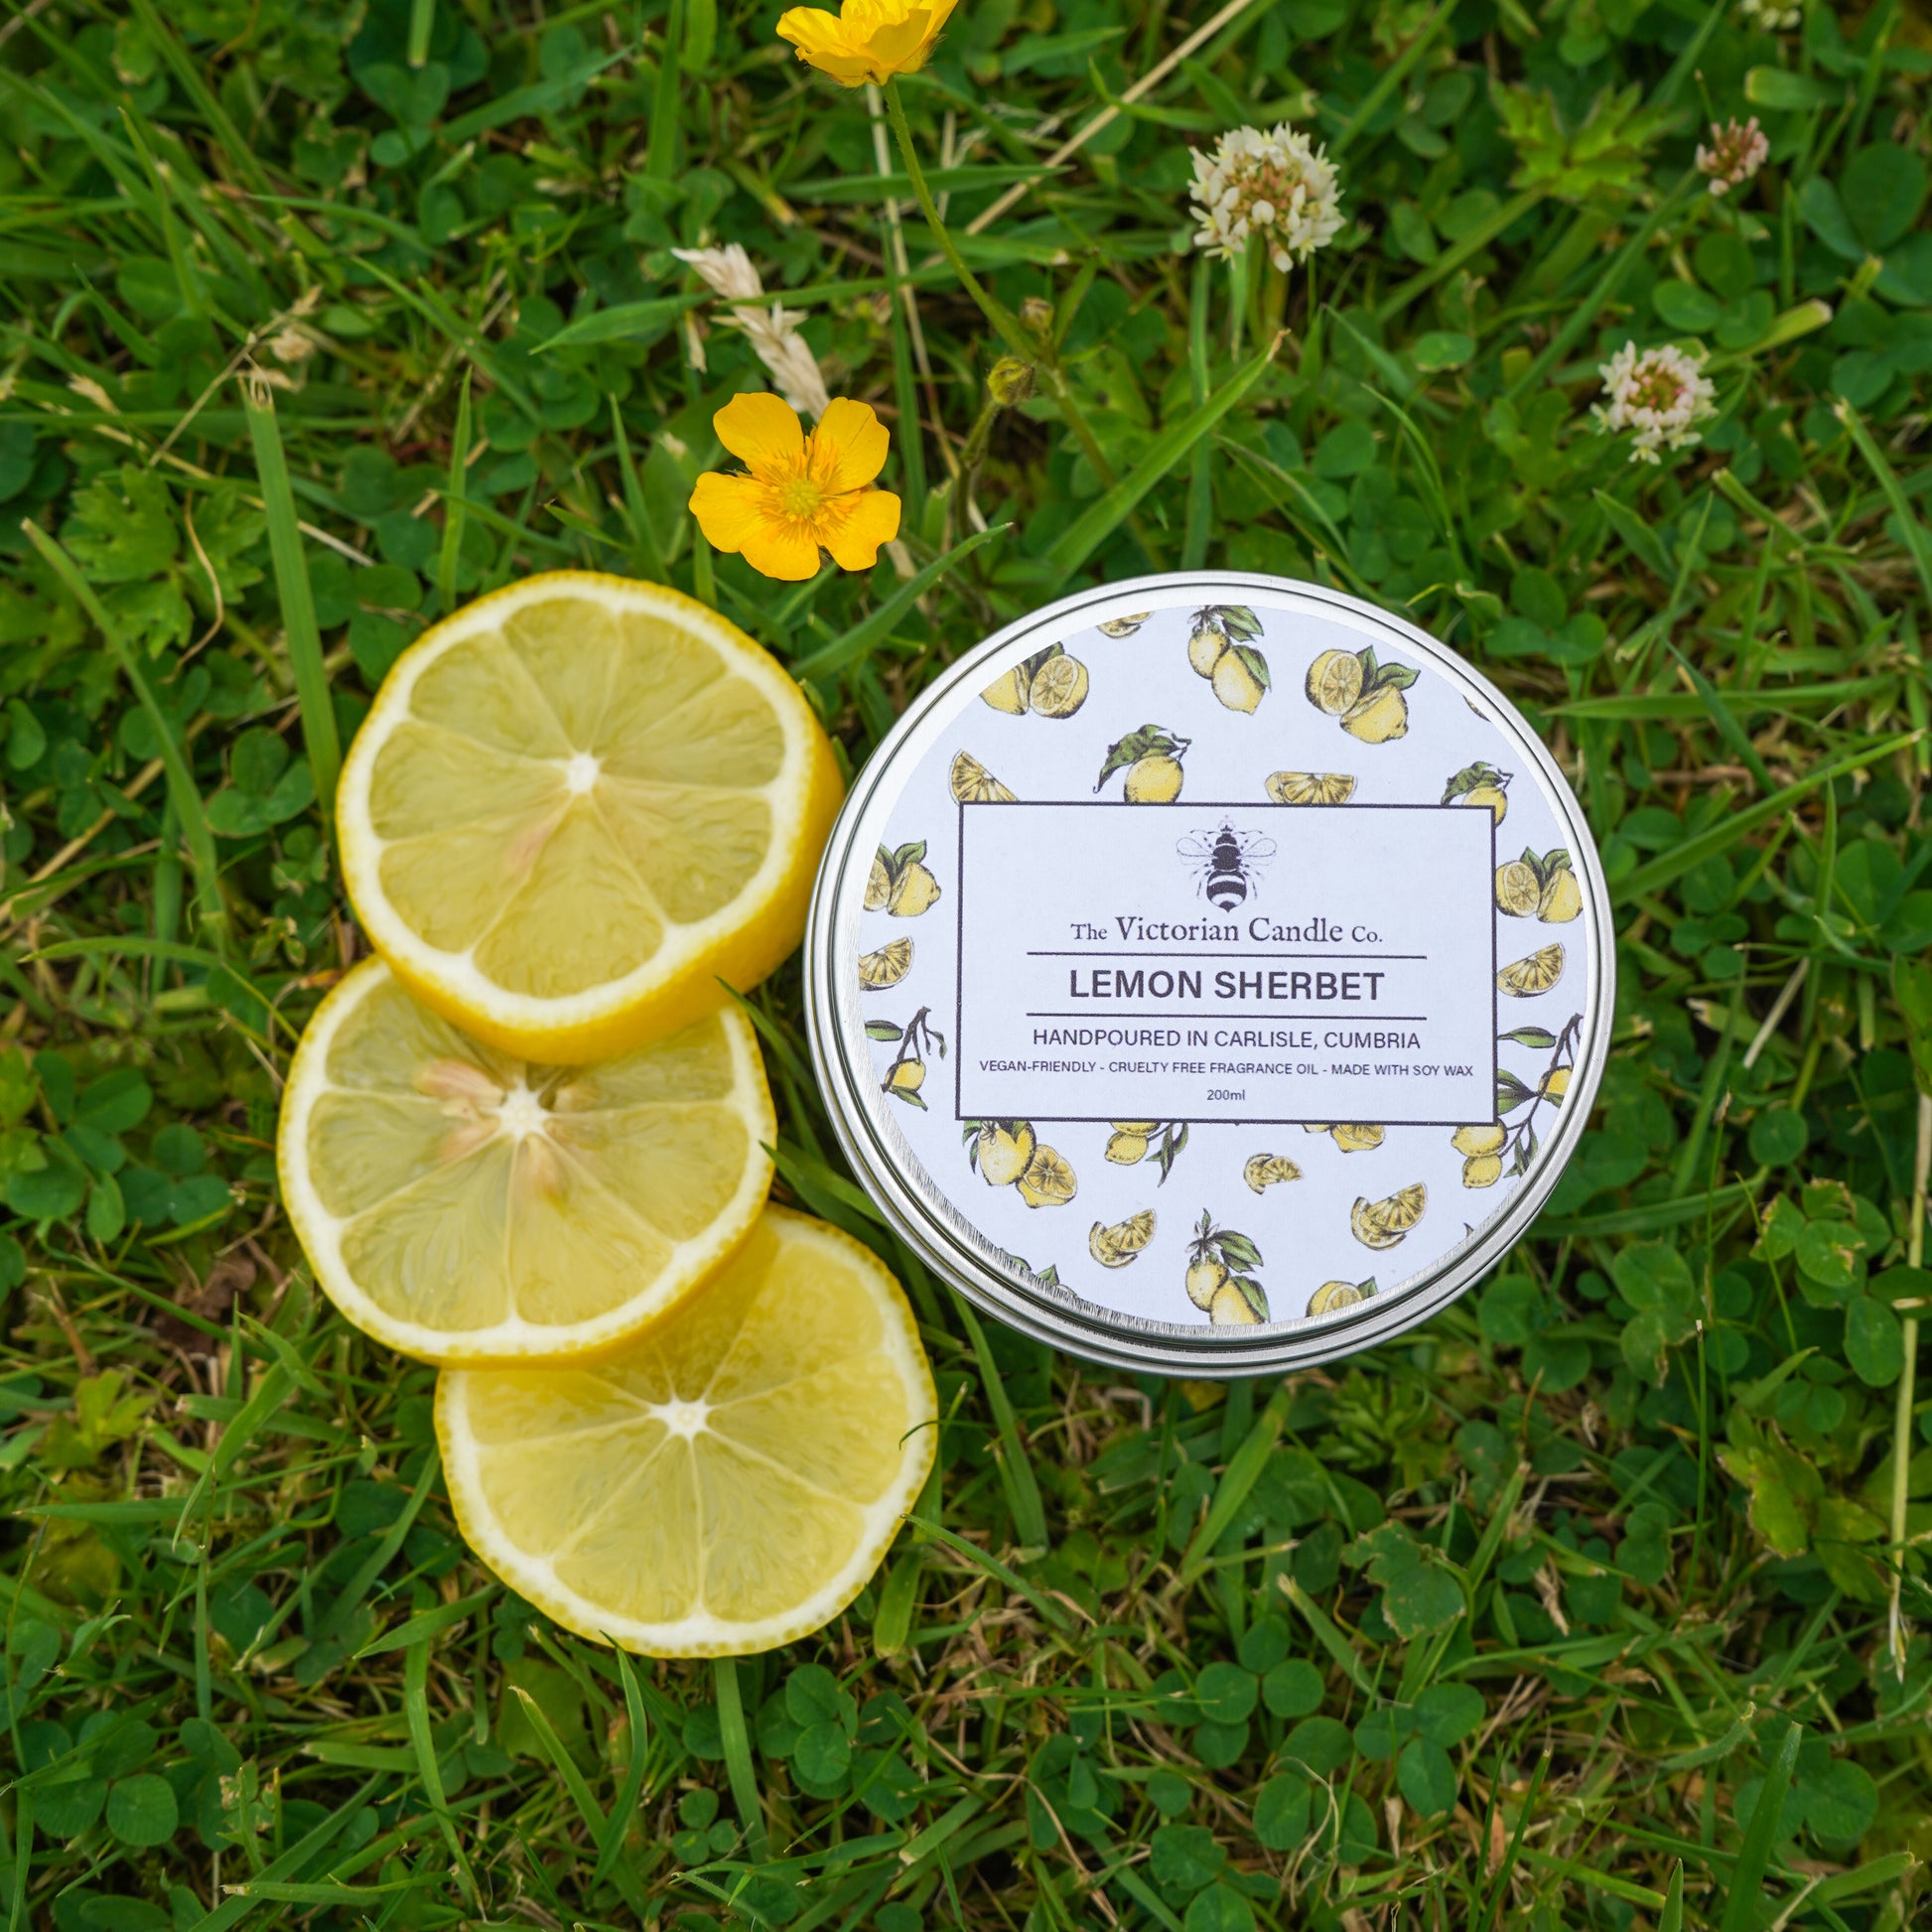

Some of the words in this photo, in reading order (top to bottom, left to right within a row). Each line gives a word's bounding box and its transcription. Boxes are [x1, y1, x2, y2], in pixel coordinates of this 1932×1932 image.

[1070, 922, 1108, 941] The
[1114, 915, 1240, 942] Victorian
[1248, 916, 1343, 943] Candle
[1351, 925, 1383, 943] Co.
[1070, 969, 1202, 999] LEMON
[1214, 970, 1386, 1001] SHERBET
[1033, 1029, 1181, 1046] HANDPOURED
[1187, 1030, 1208, 1047] IN
[1213, 1031, 1318, 1050] CARLISLE,
[1323, 1032, 1421, 1049] CUMBRIA
[979, 1059, 1097, 1073] VEGAN-FRIENDLY
[1108, 1061, 1169, 1073] CRUELTY
[1172, 1061, 1206, 1074] FREE
[1209, 1061, 1293, 1075] FRAGRANCE
[1296, 1063, 1319, 1075] OIL
[1331, 1063, 1370, 1076] MADE
[1374, 1064, 1410, 1076] WITH
[1413, 1064, 1441, 1076] SOY
[1444, 1064, 1473, 1077] WAX
[1206, 1089, 1246, 1101] 200ml
